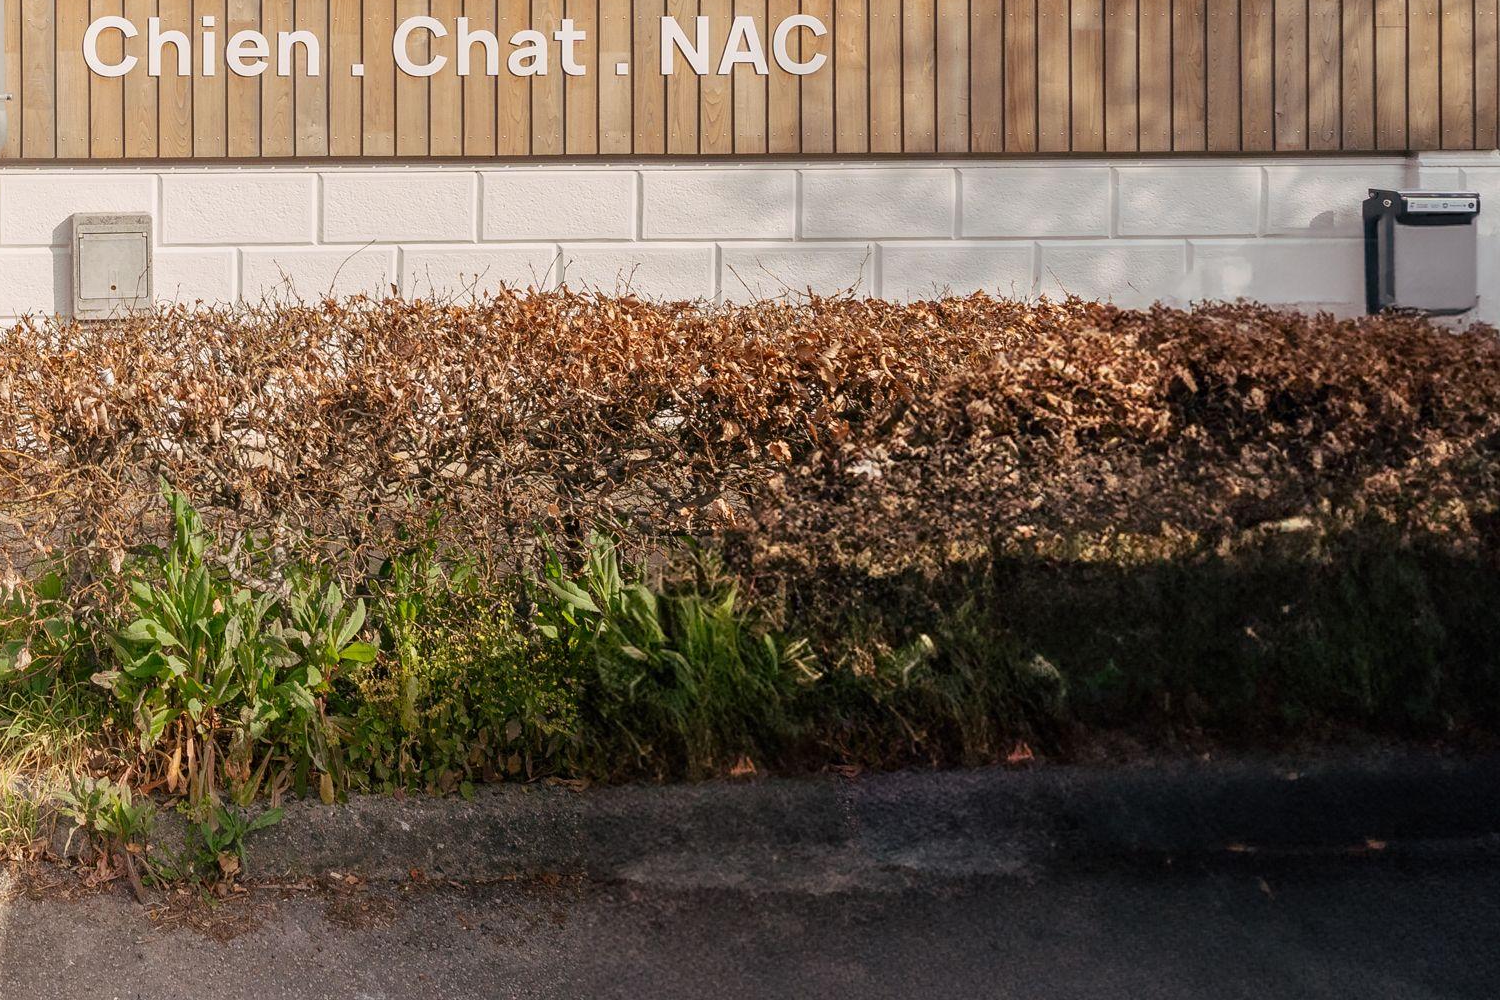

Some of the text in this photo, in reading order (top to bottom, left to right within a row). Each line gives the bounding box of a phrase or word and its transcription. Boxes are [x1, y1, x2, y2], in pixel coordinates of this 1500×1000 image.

[83, 15, 320, 77] Chien
[393, 15, 586, 77] Chat
[661, 14, 827, 76] NAC
